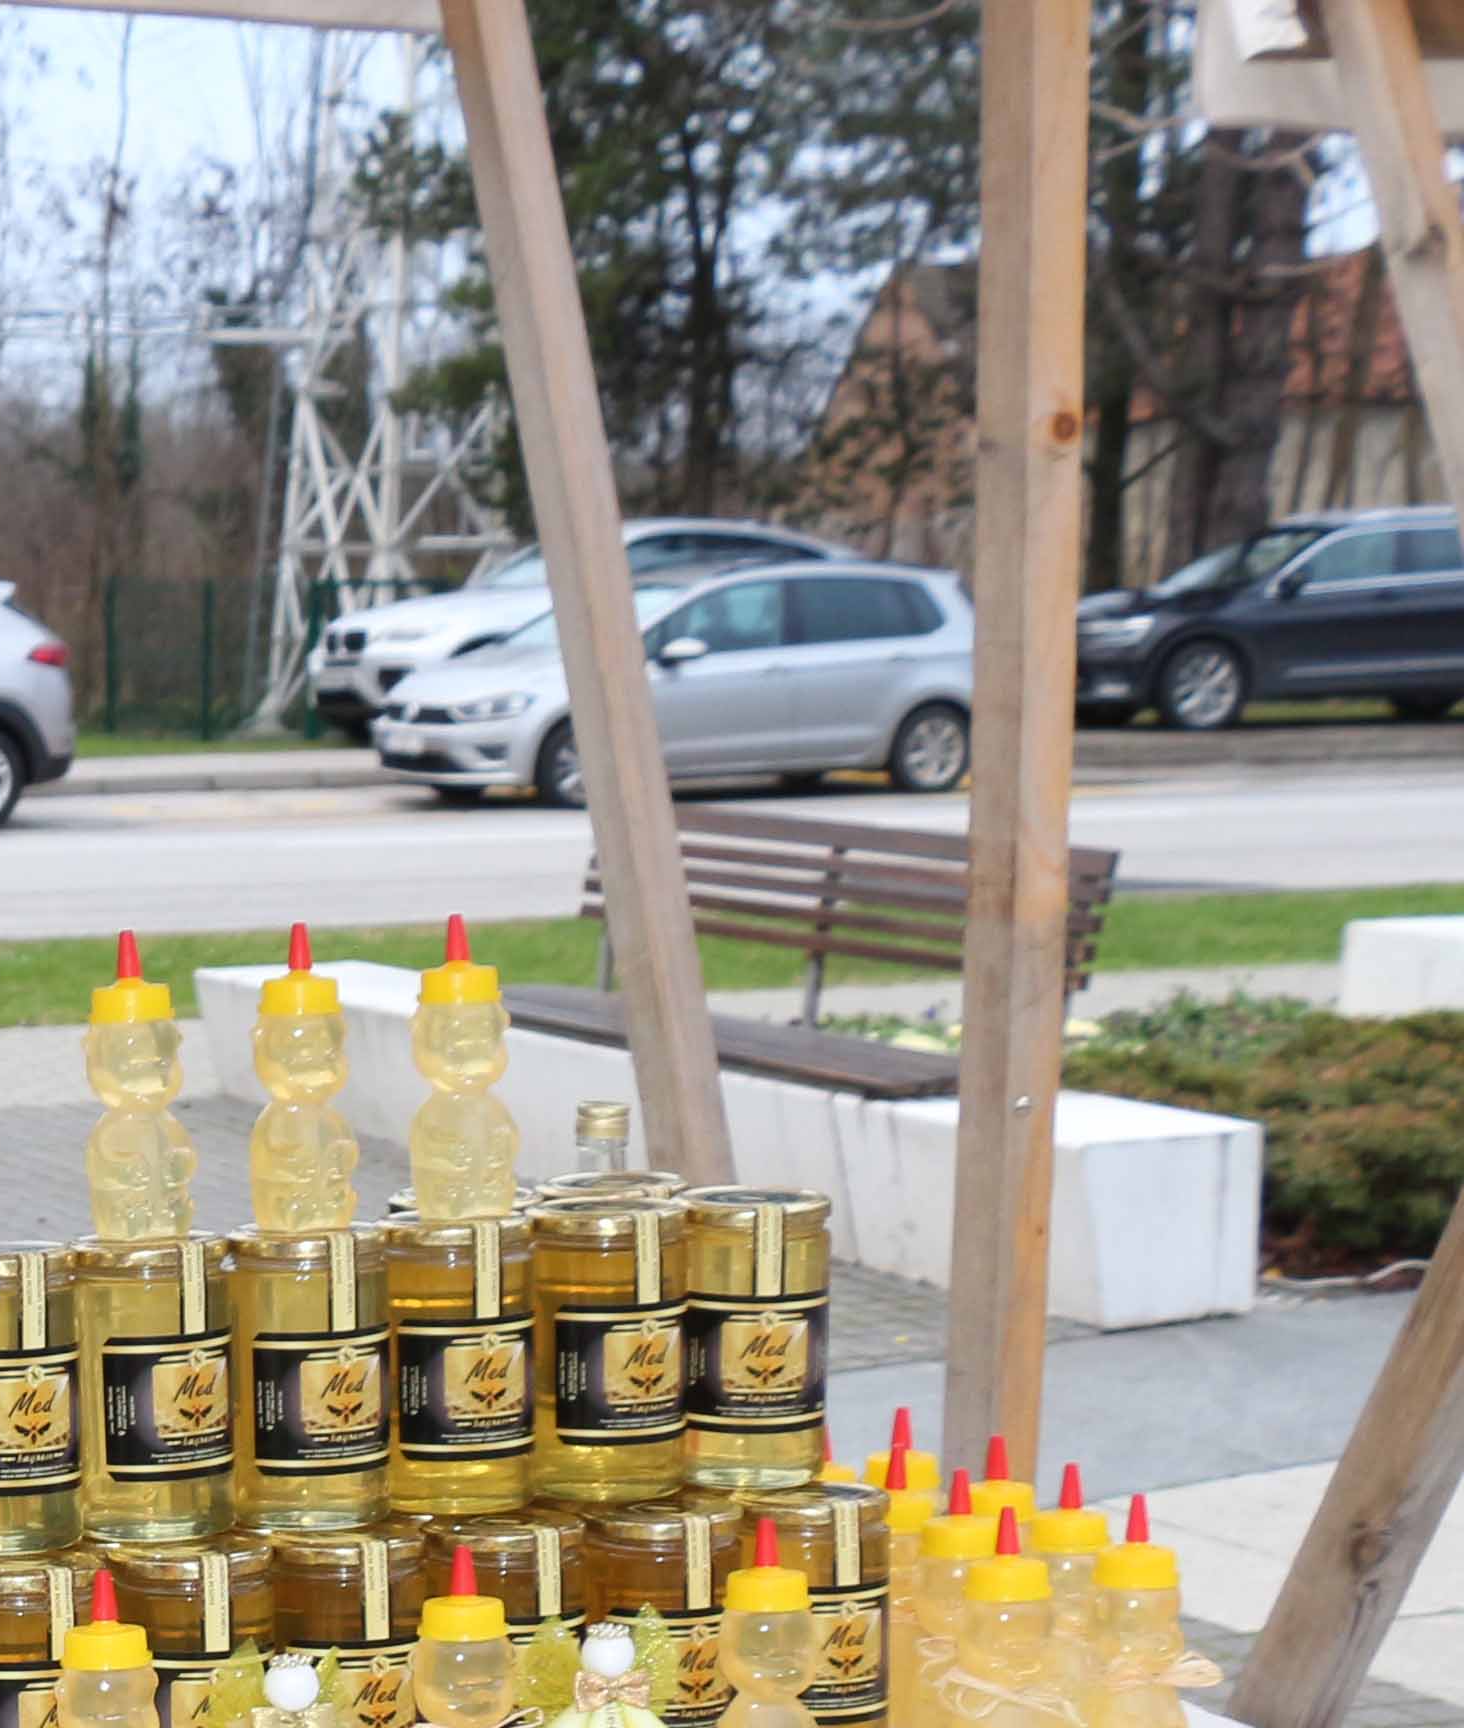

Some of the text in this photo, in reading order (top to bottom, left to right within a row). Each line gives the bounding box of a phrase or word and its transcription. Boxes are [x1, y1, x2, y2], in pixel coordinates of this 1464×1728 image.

[623, 1340, 668, 1371] Med
[740, 1331, 791, 1360] Med
[320, 1360, 371, 1399] Med
[465, 1353, 512, 1385] Med
[173, 1374, 217, 1403] Med
[8, 1390, 57, 1418] Med
[821, 1622, 868, 1650] Med
[352, 1676, 399, 1706] Med
